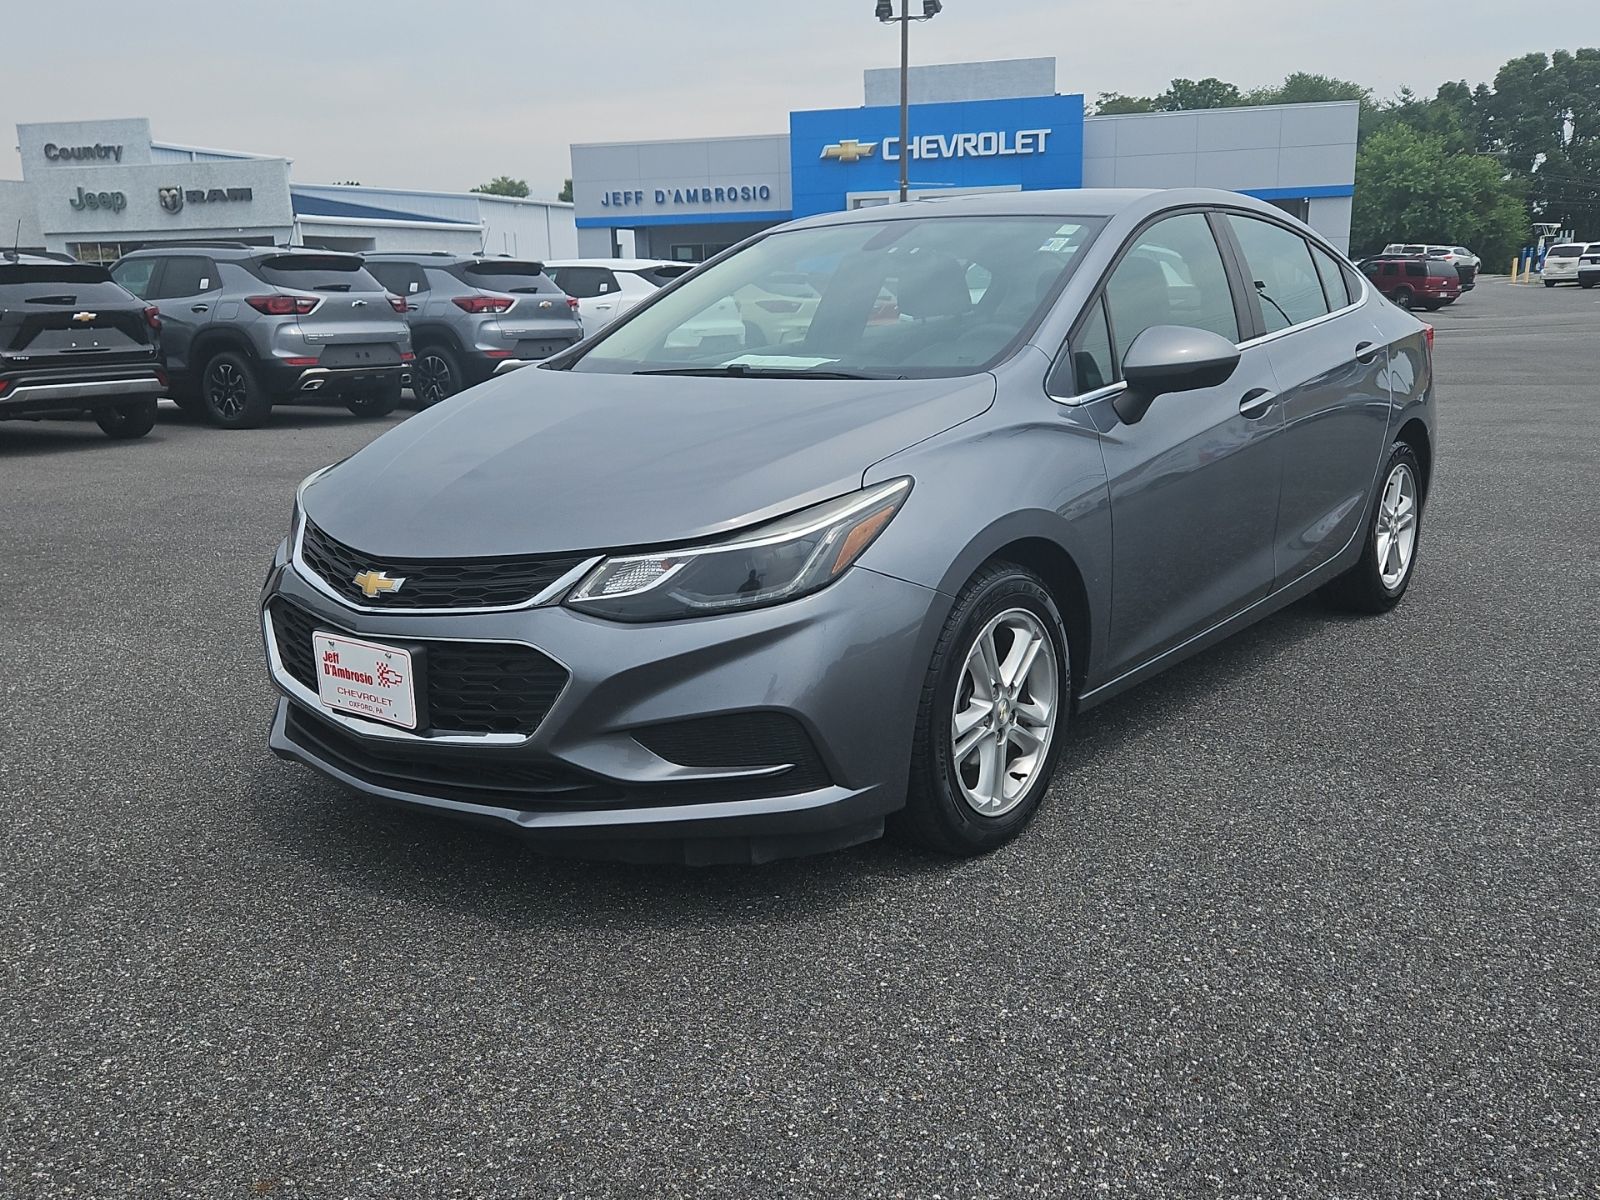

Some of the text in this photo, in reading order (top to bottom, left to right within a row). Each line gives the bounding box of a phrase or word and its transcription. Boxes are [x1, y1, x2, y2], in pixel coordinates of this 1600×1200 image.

[44, 143, 123, 163] Country
[882, 128, 1052, 161] CHEVROLET
[70, 186, 127, 213] Jeep
[185, 187, 253, 202] RAM
[601, 185, 770, 208] JEFF D'AMBROSIO
[322, 650, 339, 664] Jeff
[324, 663, 373, 685] D'Ambrosio
[337, 686, 393, 707] CHEVROLET
[348, 700, 384, 715] OXFORD, PA
